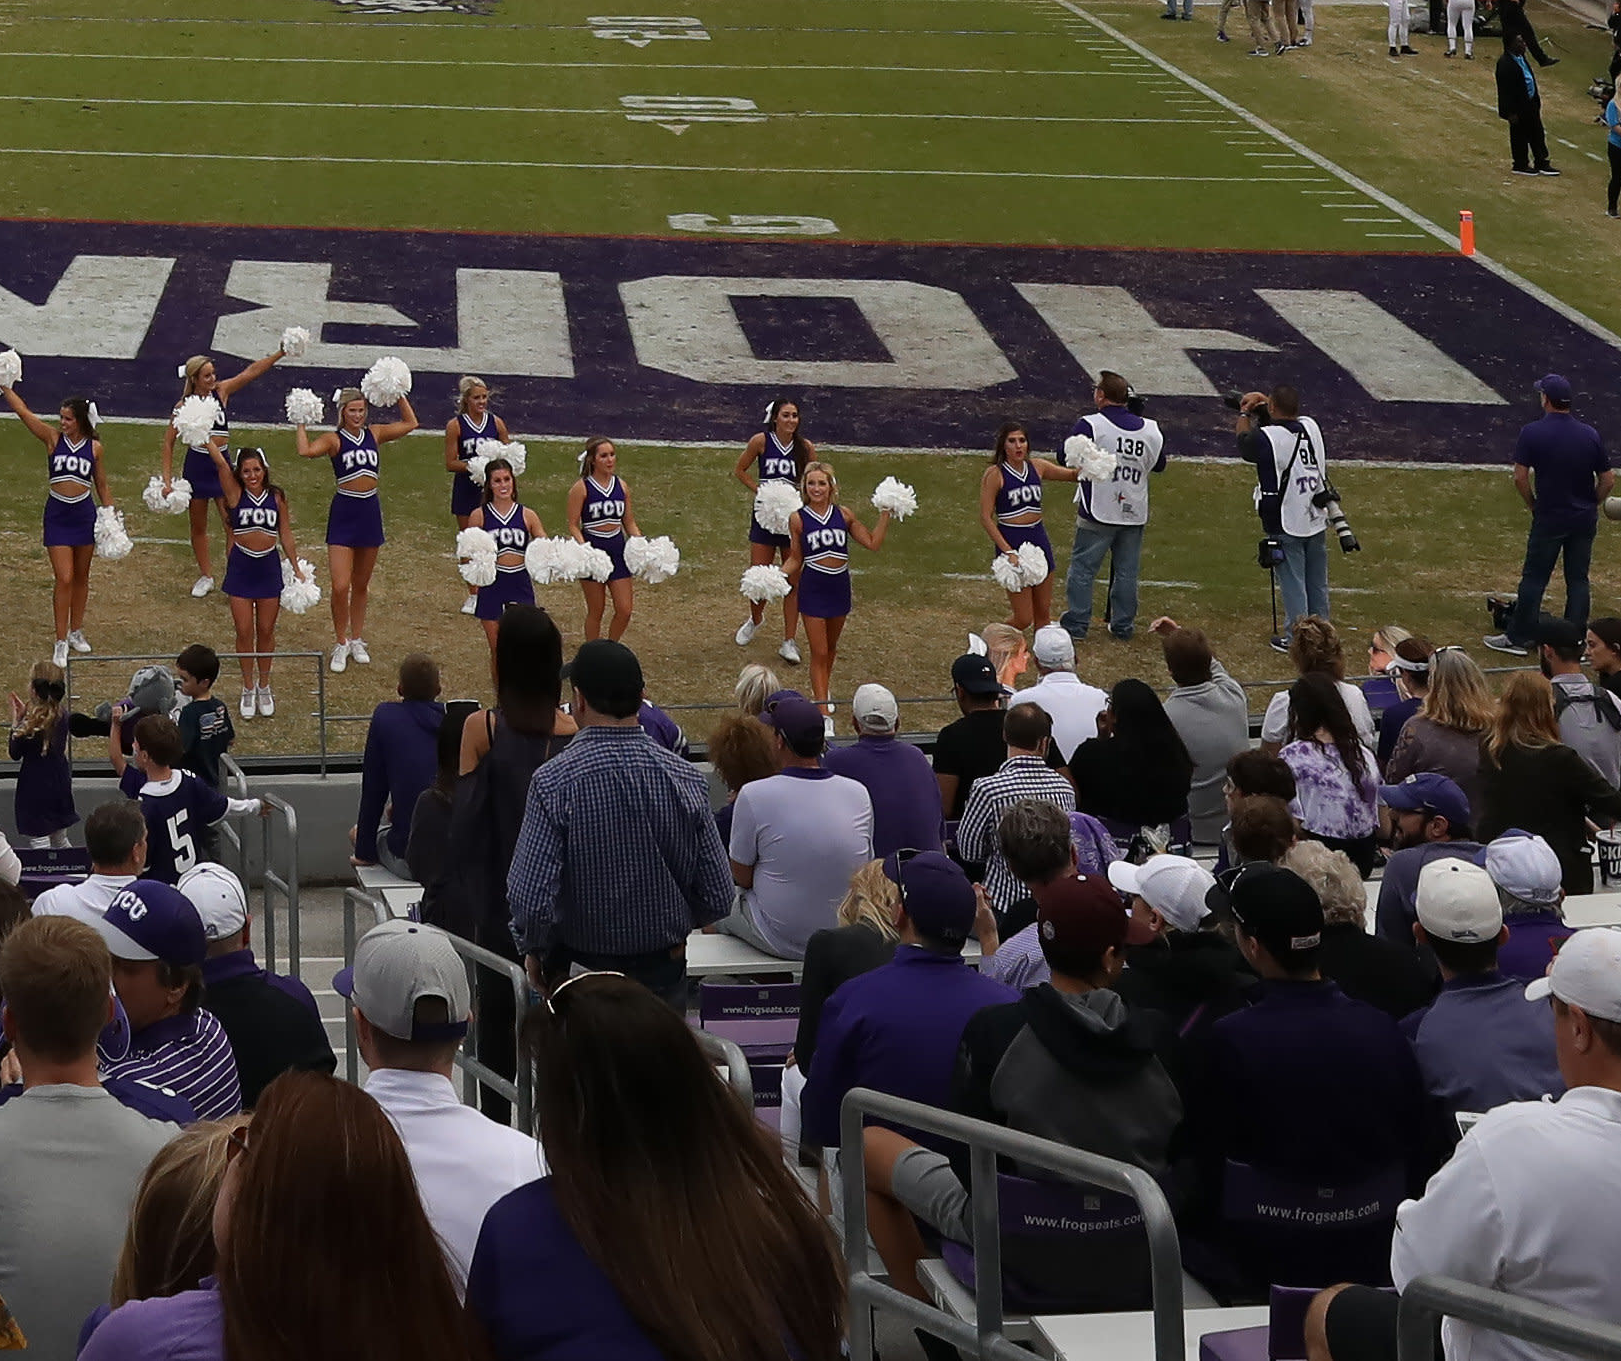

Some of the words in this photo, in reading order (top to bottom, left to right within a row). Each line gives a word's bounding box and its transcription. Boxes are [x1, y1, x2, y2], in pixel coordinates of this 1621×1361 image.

[1116, 436, 1144, 457] 138
[54, 454, 92, 477] TCU
[342, 448, 379, 469] TCU
[1113, 465, 1142, 483] TCU
[1008, 486, 1042, 507] TCU
[238, 507, 277, 527] TCU
[589, 500, 625, 519] TCU
[492, 527, 526, 546] TCU
[806, 529, 847, 552] TCU
[165, 807, 197, 875] 5
[111, 889, 149, 923] TCU
[1256, 1199, 1381, 1225] www.frogseats.com
